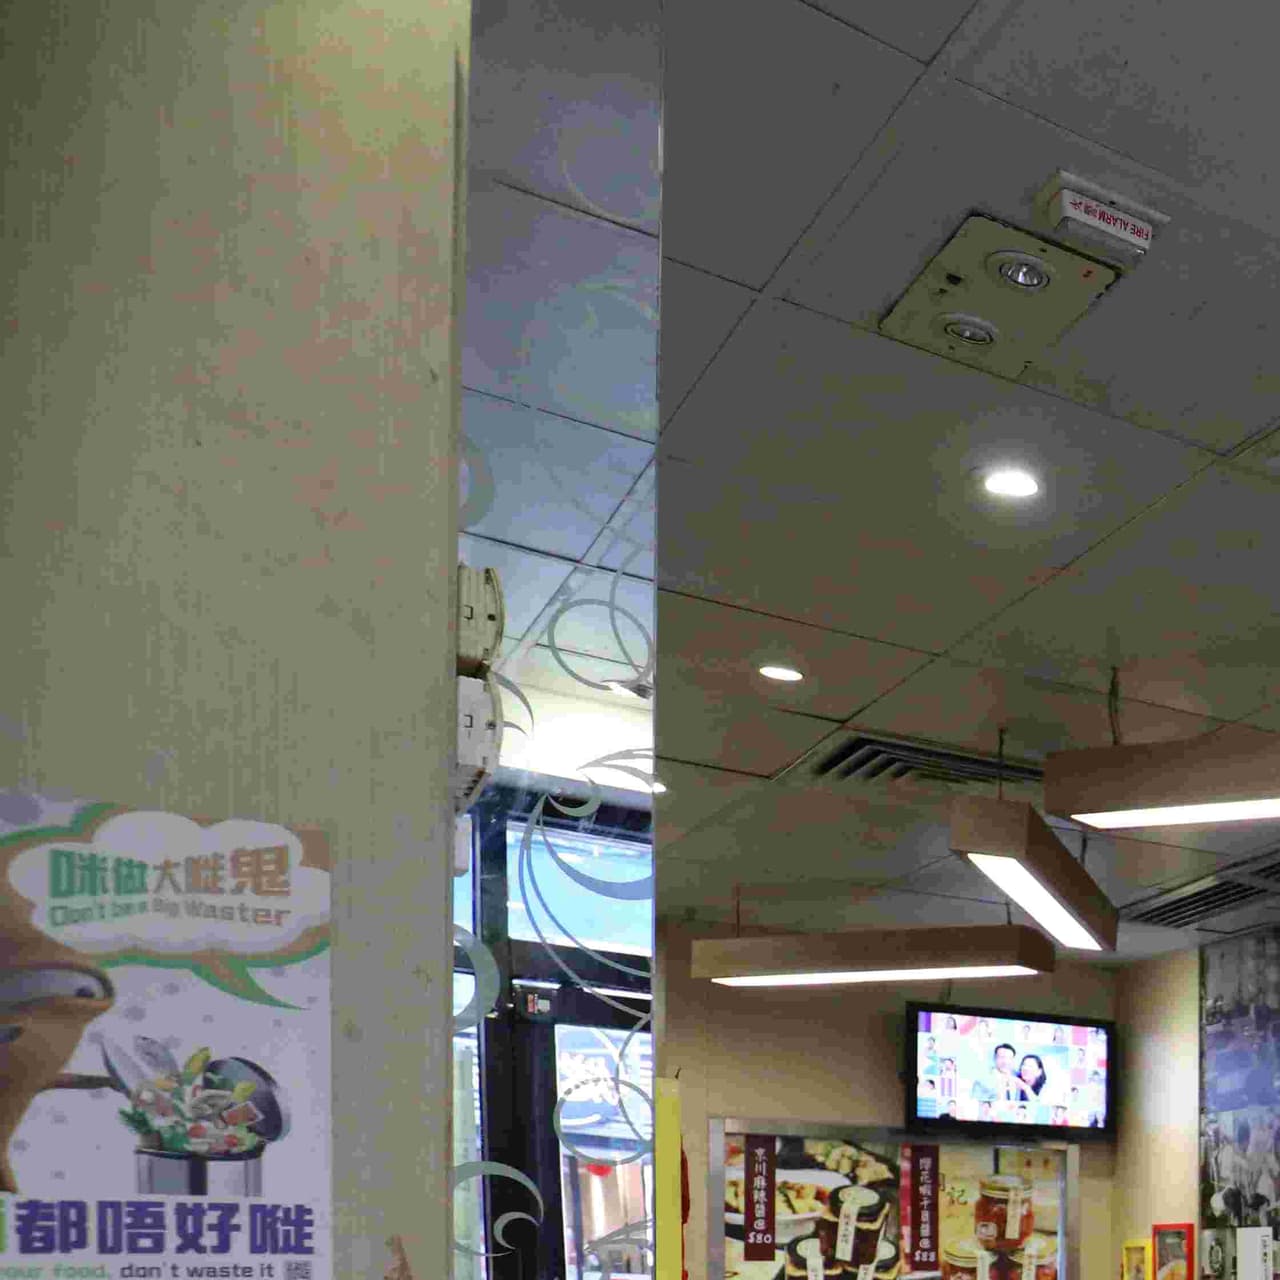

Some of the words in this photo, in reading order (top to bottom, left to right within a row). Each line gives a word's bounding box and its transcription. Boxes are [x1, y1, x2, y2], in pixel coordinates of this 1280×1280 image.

[1098, 209, 1129, 231] ALARM
[1130, 224, 1149, 240] FIRE
[120, 1261, 179, 1279] don't
[186, 1264, 253, 1279] waste
[259, 1262, 274, 1279] it
